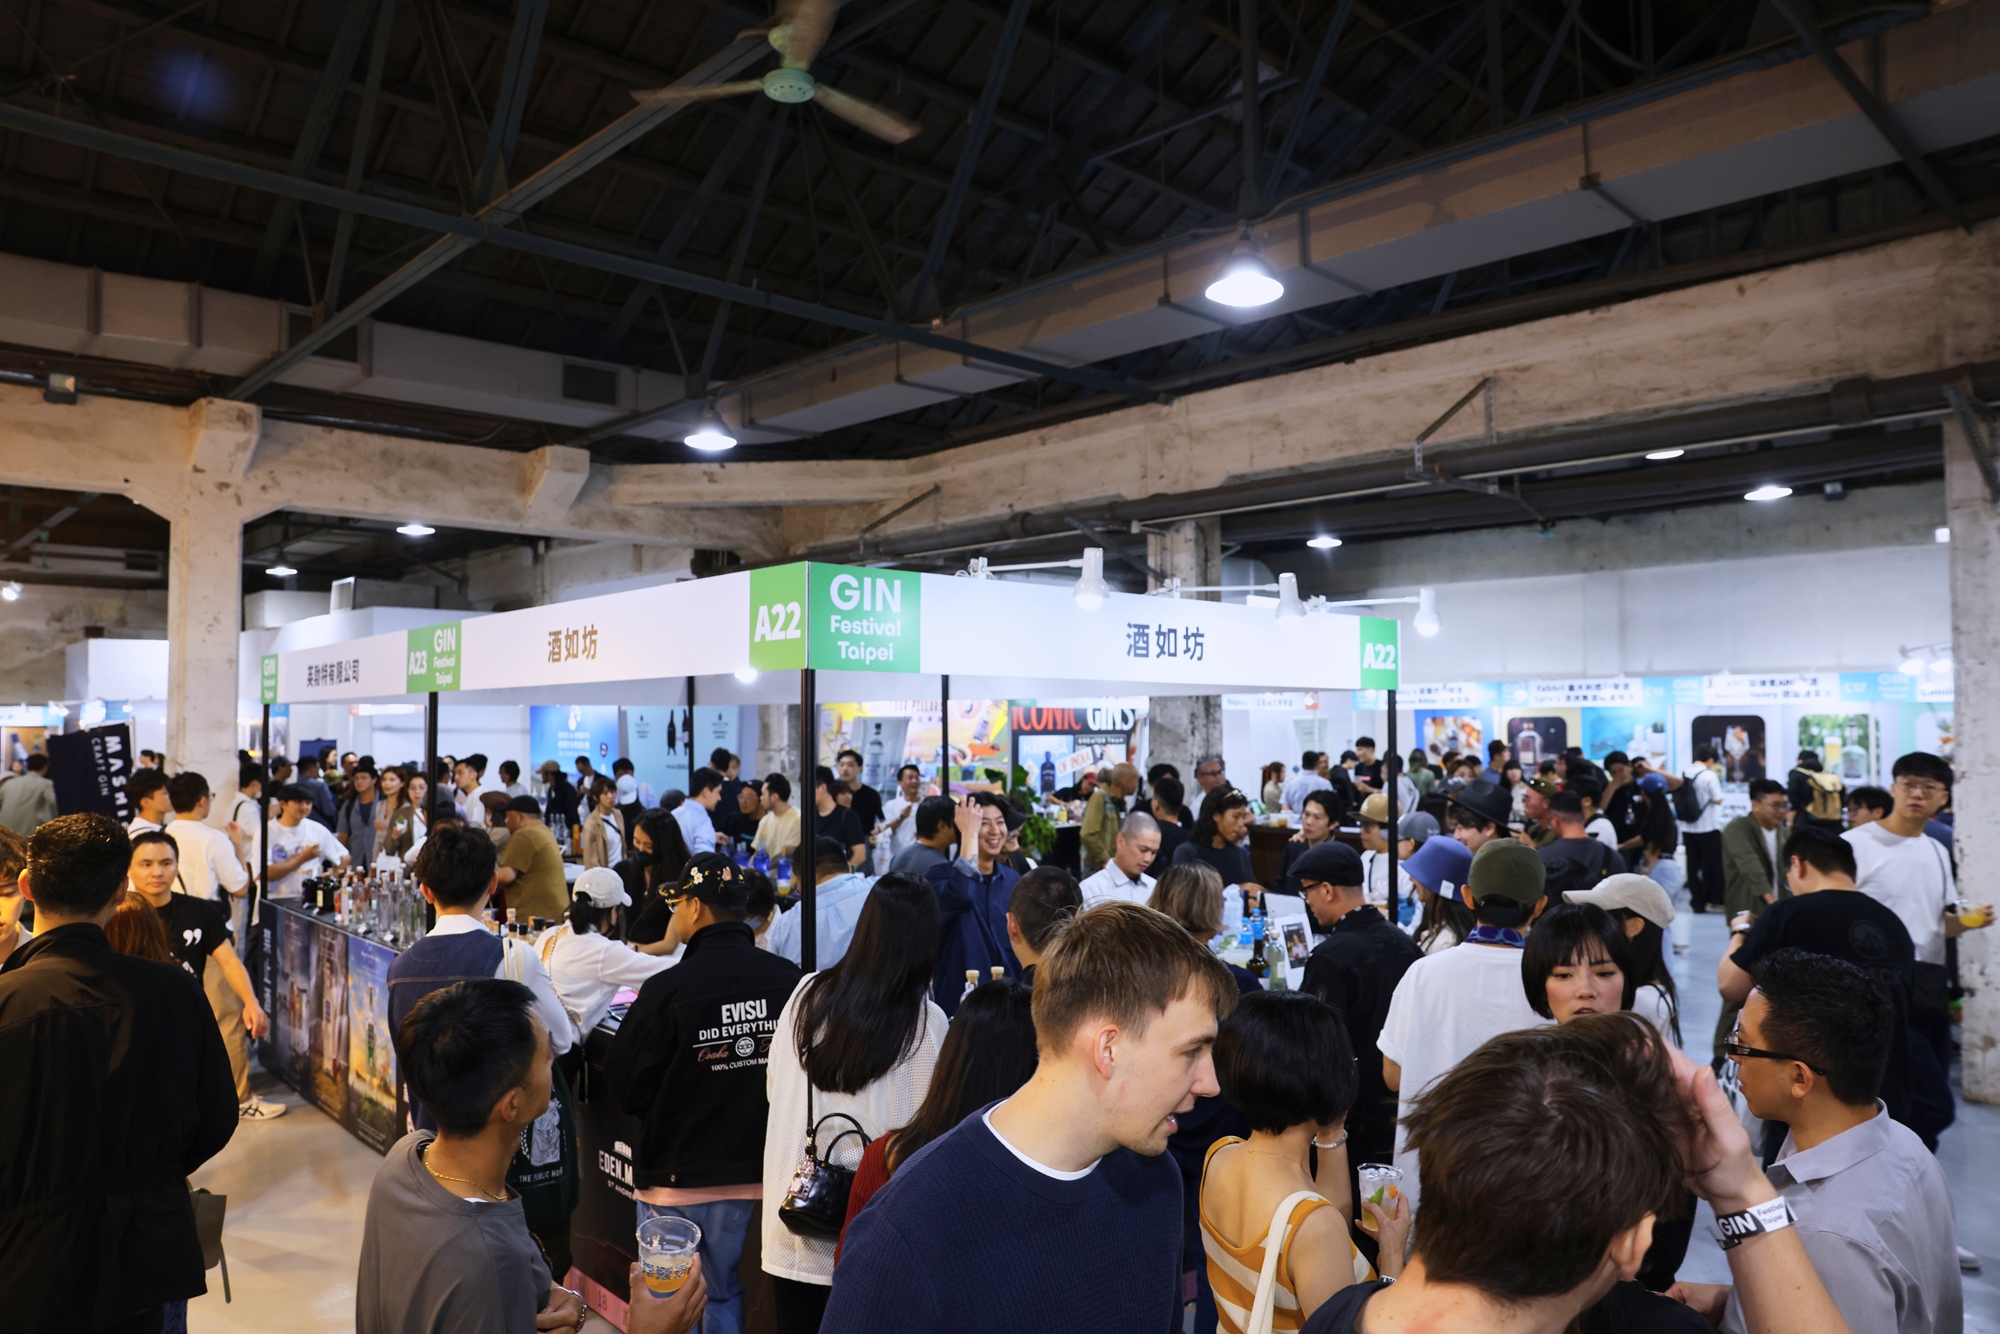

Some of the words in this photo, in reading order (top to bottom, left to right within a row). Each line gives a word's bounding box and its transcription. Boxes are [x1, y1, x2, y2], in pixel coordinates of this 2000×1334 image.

[829, 573, 902, 613] GIN
[753, 601, 802, 643] A22
[830, 614, 902, 637] Festival
[433, 627, 457, 653] GIN
[547, 623, 599, 663] 酒如坊
[836, 640, 895, 666] Taipei
[1125, 622, 1205, 662] 酒如坊
[263, 658, 276, 676] GIN
[407, 650, 428, 676] A23
[433, 654, 456, 669] Festival
[1362, 642, 1397, 671] A22
[435, 671, 453, 687] Taipei
[1012, 706, 1082, 731] ICONIC
[1087, 706, 1135, 731] GINS
[91, 737, 106, 772] CRAFT
[97, 774, 110, 797] GIN
[104, 735, 129, 827] MASHI
[721, 999, 768, 1025] EVISU
[698, 1027, 720, 1041] DID
[721, 1019, 780, 1038] EVERYTHI
[697, 1044, 730, 1063] Osaka
[711, 1063, 729, 1072] 100%
[729, 1058, 758, 1070] CUSTOM
[758, 1057, 769, 1065] MA
[518, 1174, 532, 1183] THE
[598, 1149, 636, 1189] EDEN.M
[1718, 1212, 1757, 1236] GIN
